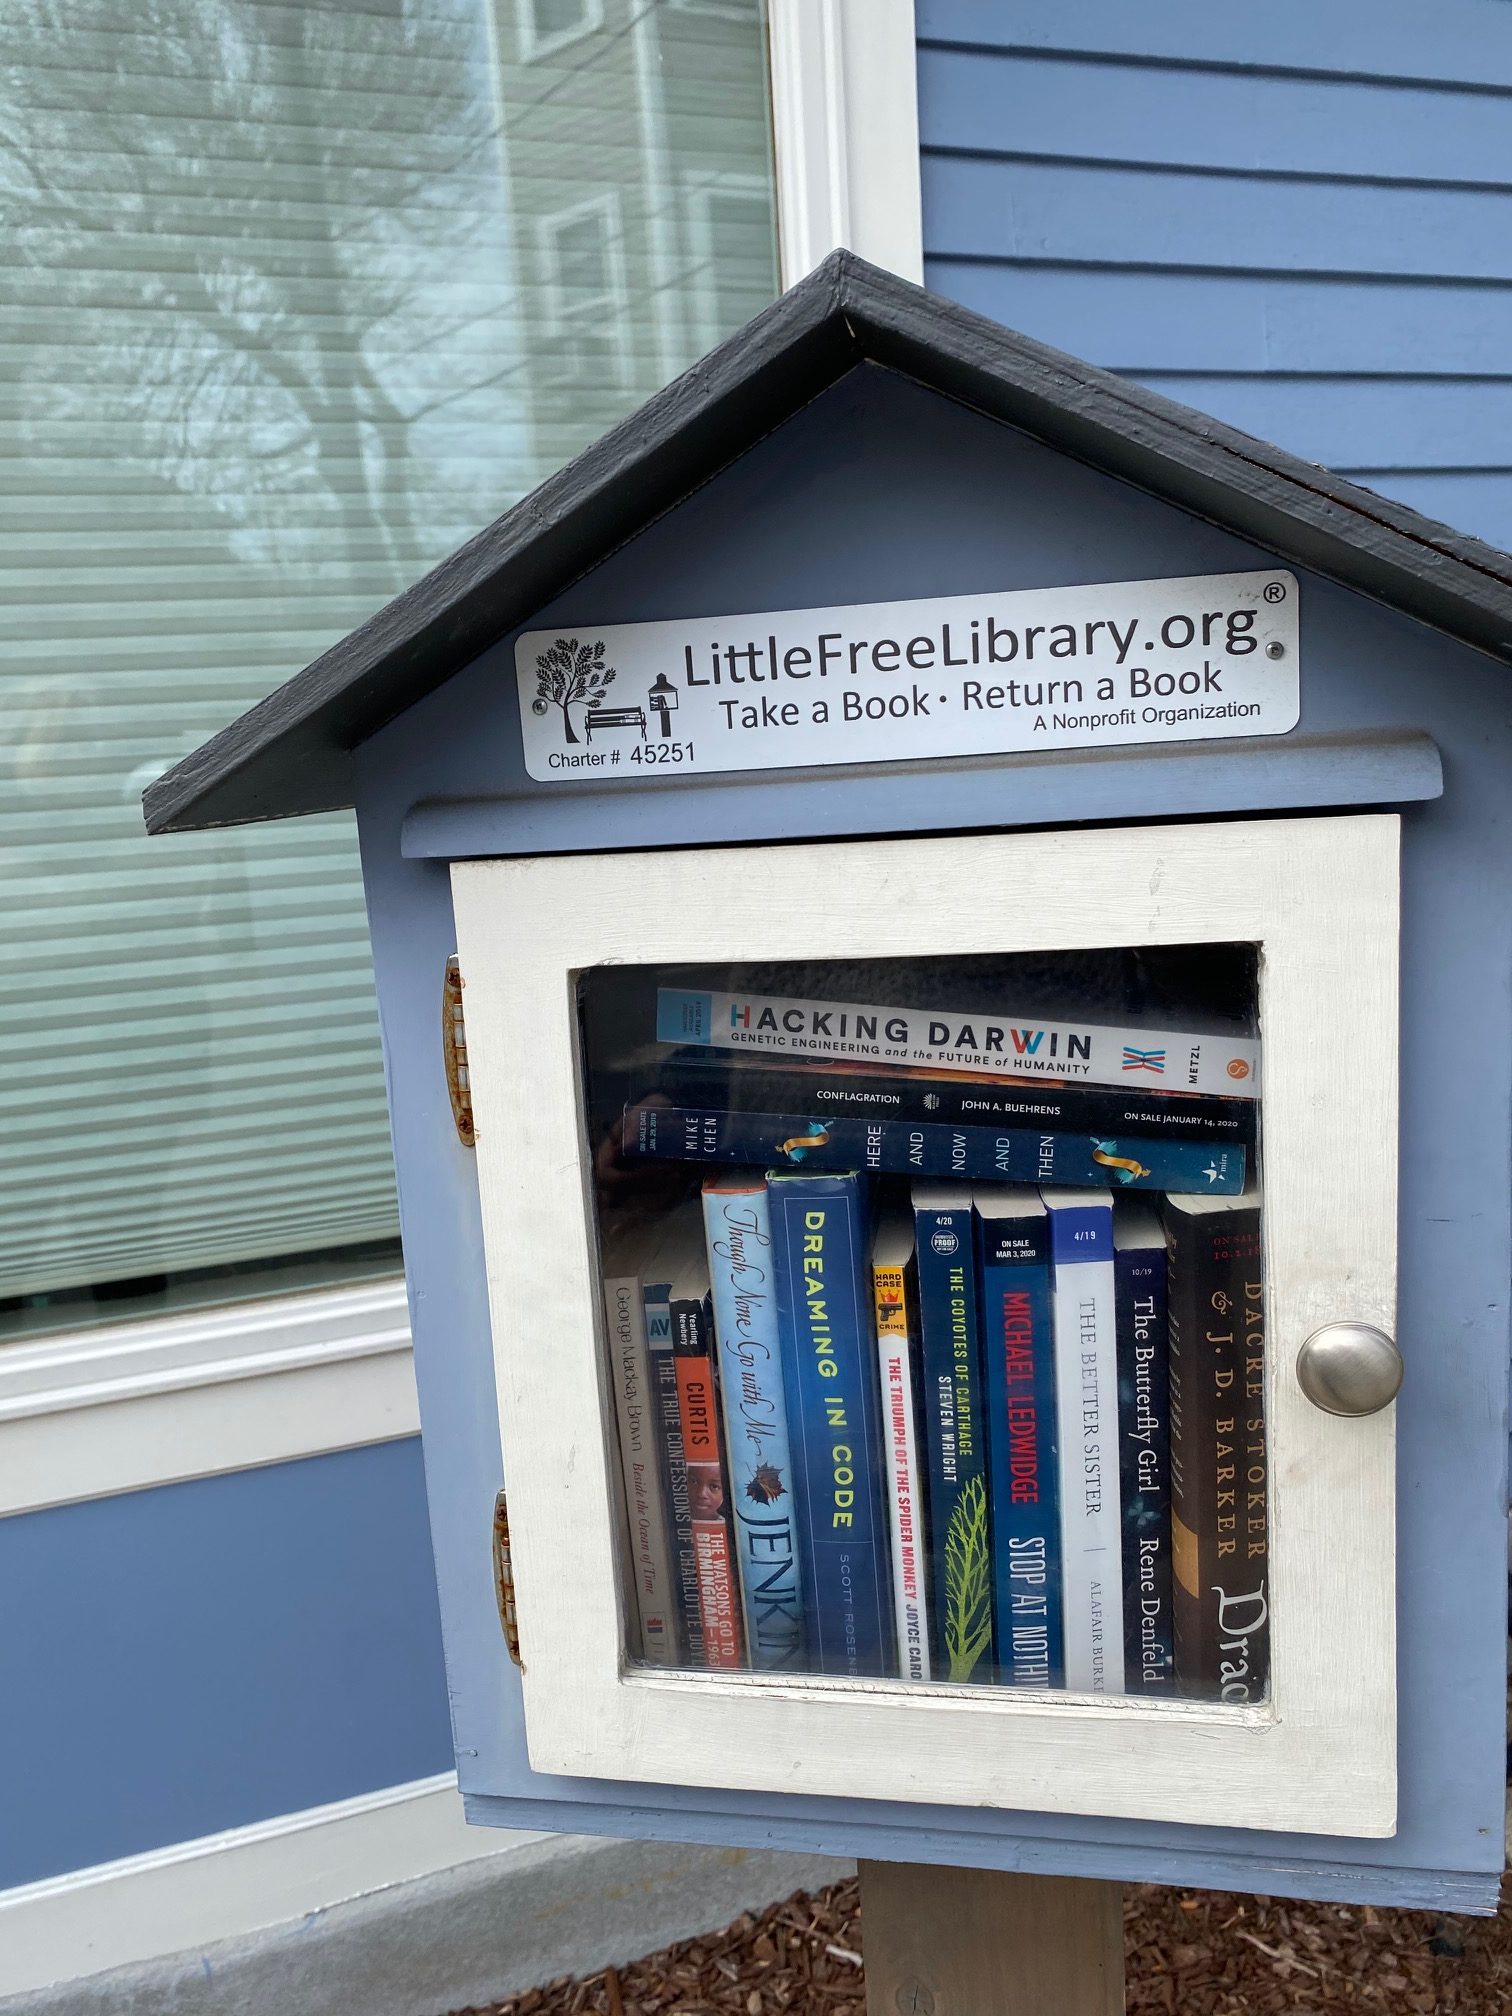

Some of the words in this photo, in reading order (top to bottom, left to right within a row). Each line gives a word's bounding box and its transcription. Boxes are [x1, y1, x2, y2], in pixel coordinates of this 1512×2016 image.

[685, 609, 1258, 686] LittleFreeLibrary.org
[718, 696, 800, 729] Take
[811, 702, 830, 722] a
[844, 685, 931, 722] Book
[962, 677, 1084, 712] Return
[1097, 677, 1114, 700] a
[1130, 661, 1222, 698] Book
[1033, 715, 1047, 731] A
[1053, 708, 1136, 731] Nonprofit
[1142, 700, 1261, 726] Organization
[549, 752, 606, 768] Charter
[611, 750, 620, 765] #
[630, 742, 695, 765] 45251
[731, 1004, 909, 1043] HACKING
[929, 1022, 1092, 1060] DARWIN
[731, 1032, 787, 1046] GENETIC
[791, 1037, 880, 1055] ENGINEERING
[885, 1047, 908, 1057] and
[913, 1048, 932, 1060] the
[938, 1052, 989, 1066] FUTURE
[995, 1056, 1009, 1067] of
[1014, 1058, 1090, 1075] HUMANITY
[1189, 1045, 1200, 1084] METZL
[816, 1090, 900, 1104] CONFLAGRATION
[961, 1100, 990, 1113] JOHN
[993, 1102, 1002, 1112] A.
[1005, 1103, 1061, 1115] BUEHRENS
[685, 1116, 699, 1150] MIKE
[703, 1117, 717, 1153] CHEN
[1124, 1112, 1138, 1121] ON
[1140, 1113, 1162, 1122] SALE
[1163, 1115, 1202, 1126] JANUARY
[1204, 1118, 1216, 1128] 14,
[1218, 1119, 1239, 1128] 2020
[867, 1125, 882, 1167] HERE
[909, 1131, 923, 1165] AND
[952, 1134, 966, 1170] NOW
[996, 1137, 1010, 1171] AND
[1039, 1136, 1054, 1178] THEN
[936, 1217, 952, 1225] 4/20
[1074, 1231, 1096, 1241] 4/19
[996, 1250, 1010, 1258] MAR
[1012, 1250, 1019, 1259] 3,
[1020, 1249, 1036, 1258] 2020
[1002, 1240, 1011, 1248] ON
[1013, 1239, 1029, 1248] SALE
[876, 1273, 902, 1281] HARD
[876, 1280, 902, 1288] CASE
[950, 1267, 964, 1292] THE
[1132, 1268, 1152, 1276] 10/19
[616, 1287, 633, 1343] George
[731, 1273, 767, 1337] None
[804, 1211, 839, 1378] DREAMING
[1211, 1291, 1233, 1315] &
[679, 1313, 688, 1346] Newbery
[690, 1313, 698, 1345] Yearling
[951, 1298, 967, 1358] COYOTES
[1003, 1292, 1035, 1385] MICHAEL
[1079, 1297, 1096, 1345] THE
[1134, 1295, 1156, 1340] The
[1244, 1281, 1264, 1397] DACRE
[622, 1346, 643, 1401] Mackay
[658, 1357, 676, 1384] THE
[888, 1357, 902, 1382] THE
[955, 1365, 968, 1381] OF
[661, 1391, 680, 1427] TRUE
[741, 1371, 776, 1412] with
[824, 1397, 847, 1426] IN
[938, 1376, 954, 1426] STEVEN
[1081, 1352, 1099, 1437] BETTER
[1128, 1345, 1159, 1444] Butterfly
[627, 1405, 642, 1451] Brown
[687, 1382, 709, 1445] CURTIS
[739, 1403, 777, 1456] Me
[889, 1386, 906, 1445] TRIUMPH
[956, 1387, 972, 1456] CARTHAGE
[895, 1449, 908, 1466] OF
[941, 1433, 957, 1482] WRIGHT
[1008, 1395, 1038, 1504] LEDWIDGE
[632, 1463, 648, 1500] Beside
[666, 1432, 691, 1525] CONFESSIONS
[832, 1445, 854, 1528] CODE
[896, 1469, 910, 1494] THE
[1084, 1444, 1101, 1516] SISTER
[1138, 1449, 1160, 1493] Girl
[1215, 1419, 1235, 1559] BARKER
[1246, 1419, 1267, 1559] STOKER
[636, 1501, 648, 1516] the
[898, 1497, 914, 1543] SPIDER
[638, 1519, 650, 1551] Ocean
[677, 1529, 693, 1544] OF
[709, 1533, 725, 1555] THE
[639, 1553, 653, 1567] of
[641, 1568, 656, 1594] Time
[840, 1554, 853, 1604] SCOTT
[901, 1546, 917, 1600] MONKEY
[1009, 1537, 1046, 1584] STOP
[1139, 1537, 1159, 1592] Rene
[679, 1550, 702, 1628] CHARLOTTE
[711, 1558, 731, 1616] WATSONS
[1011, 1593, 1047, 1616] AT
[719, 1619, 732, 1637] GO
[905, 1604, 920, 1644] JOYCE
[1090, 1581, 1104, 1643] ALAFAIR
[721, 1641, 734, 1656] TO
[1141, 1597, 1164, 1683] Denfeld
[909, 1647, 922, 1680] CARO
